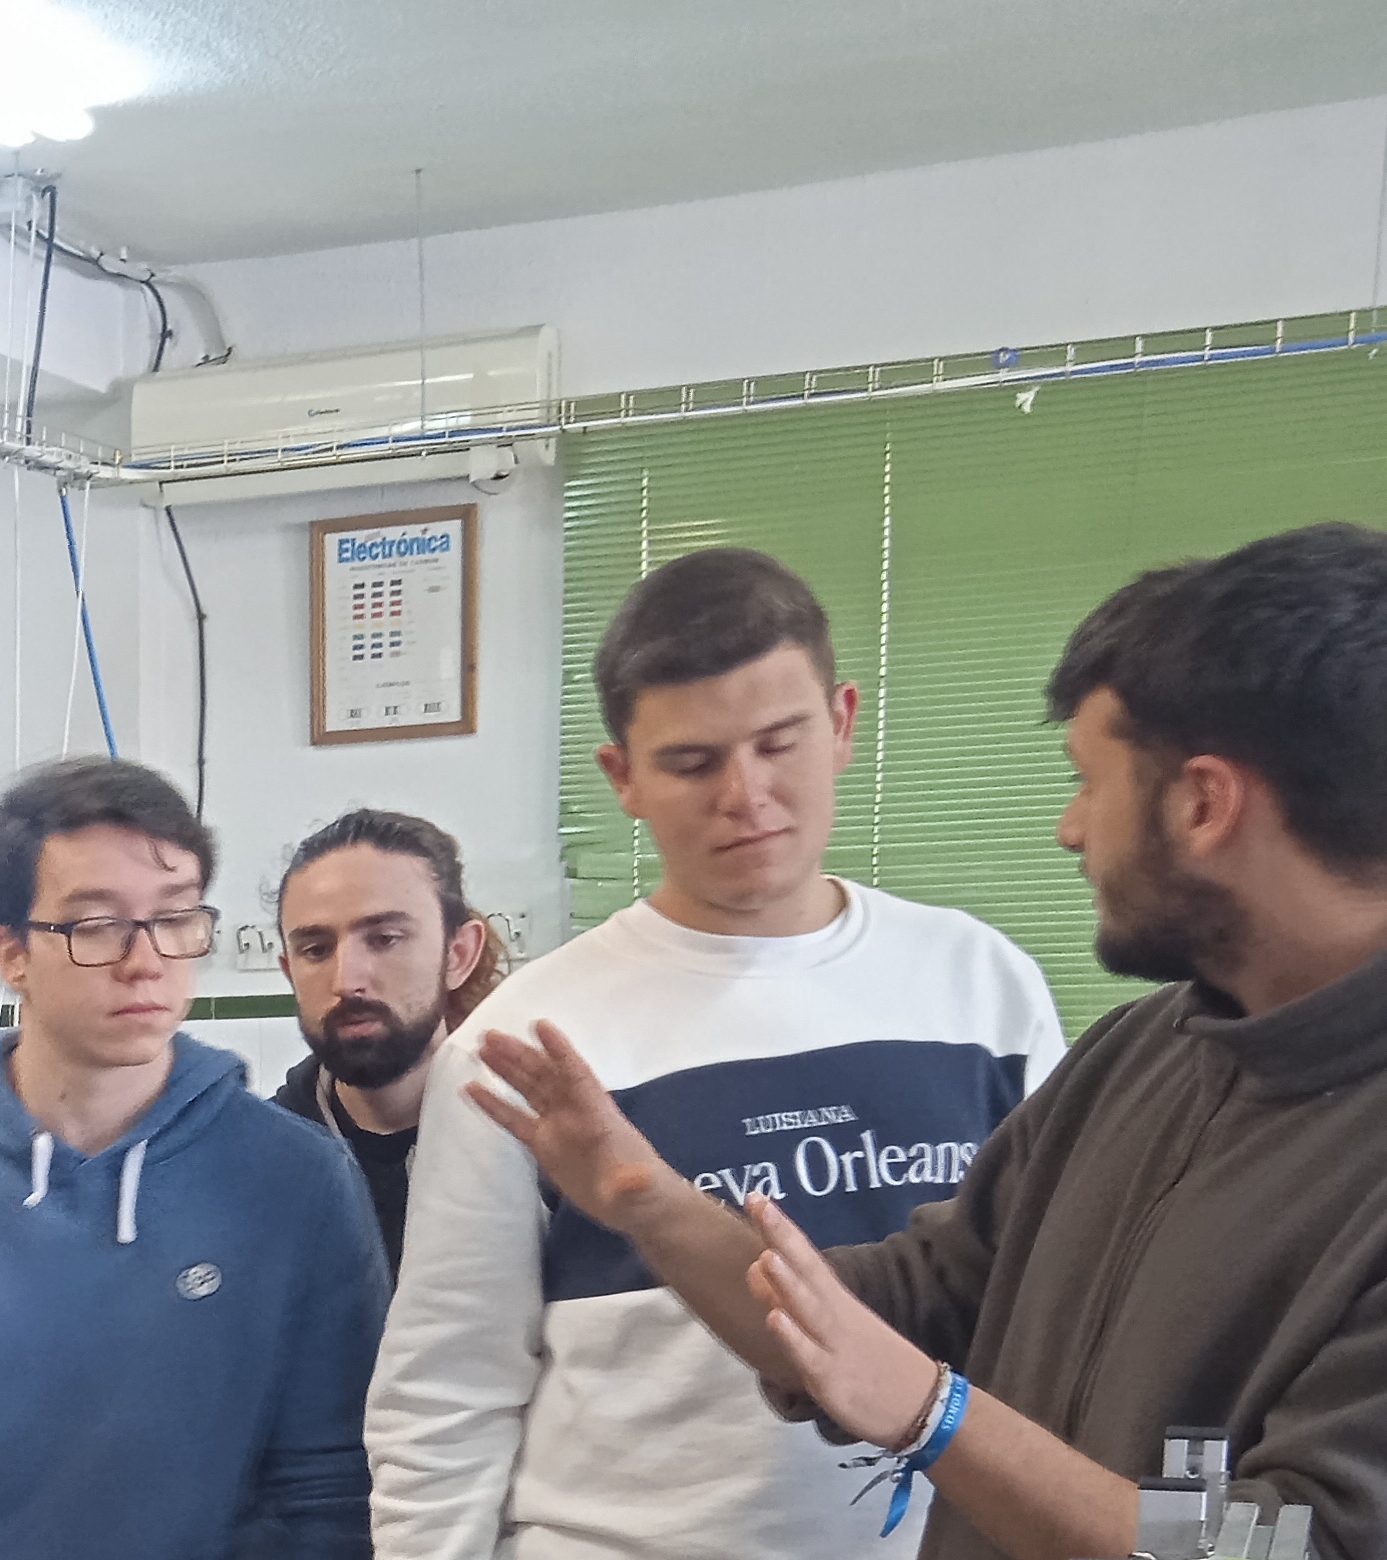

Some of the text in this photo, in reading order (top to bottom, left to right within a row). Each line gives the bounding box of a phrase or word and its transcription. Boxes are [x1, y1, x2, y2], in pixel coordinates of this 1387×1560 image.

[337, 531, 451, 564] Electrónica
[741, 1105, 859, 1136] LUISIANA
[683, 1162, 788, 1207] eva
